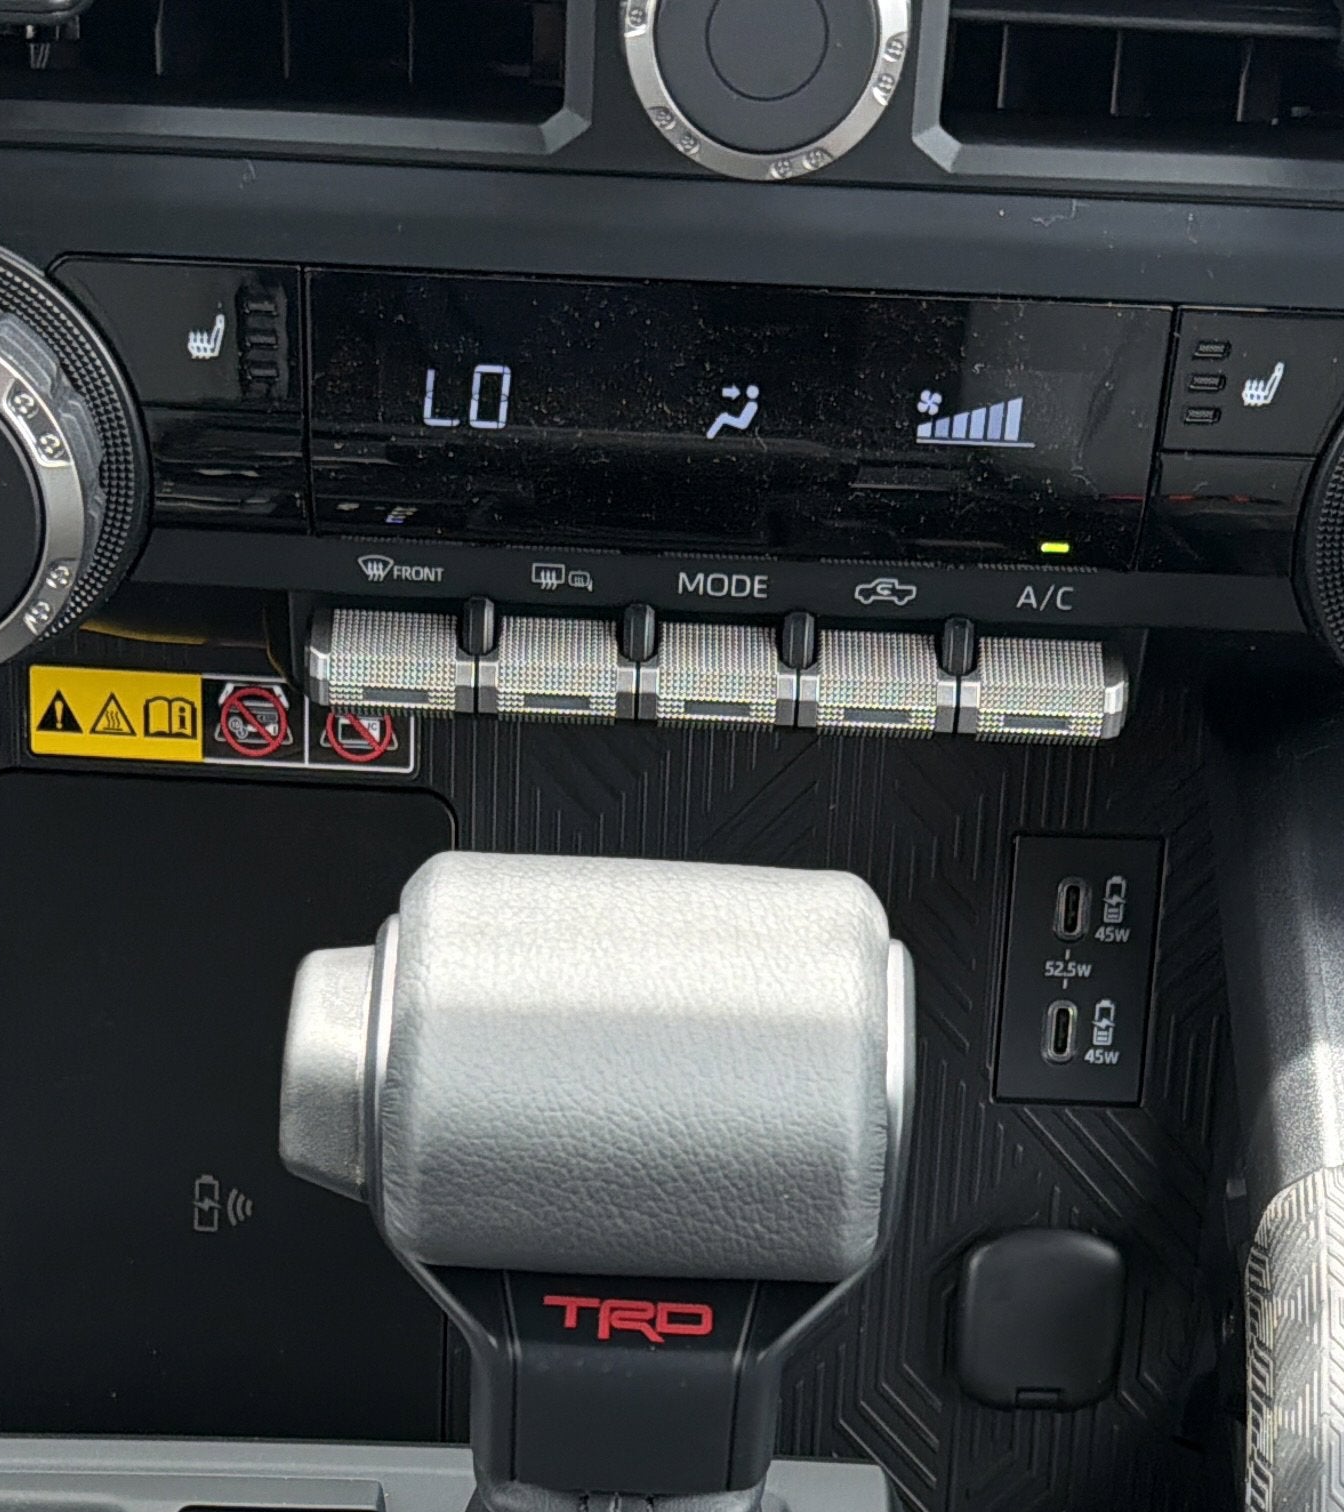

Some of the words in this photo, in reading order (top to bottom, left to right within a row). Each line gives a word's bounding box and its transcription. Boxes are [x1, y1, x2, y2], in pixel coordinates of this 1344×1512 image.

[393, 564, 444, 582] FRONT
[677, 572, 768, 598] MODE
[1015, 585, 1075, 611] A/C
[1094, 926, 1130, 943] 45W
[1043, 960, 1092, 977] 52.5W
[1084, 1048, 1120, 1065] 45W
[542, 1295, 714, 1343] TRD
